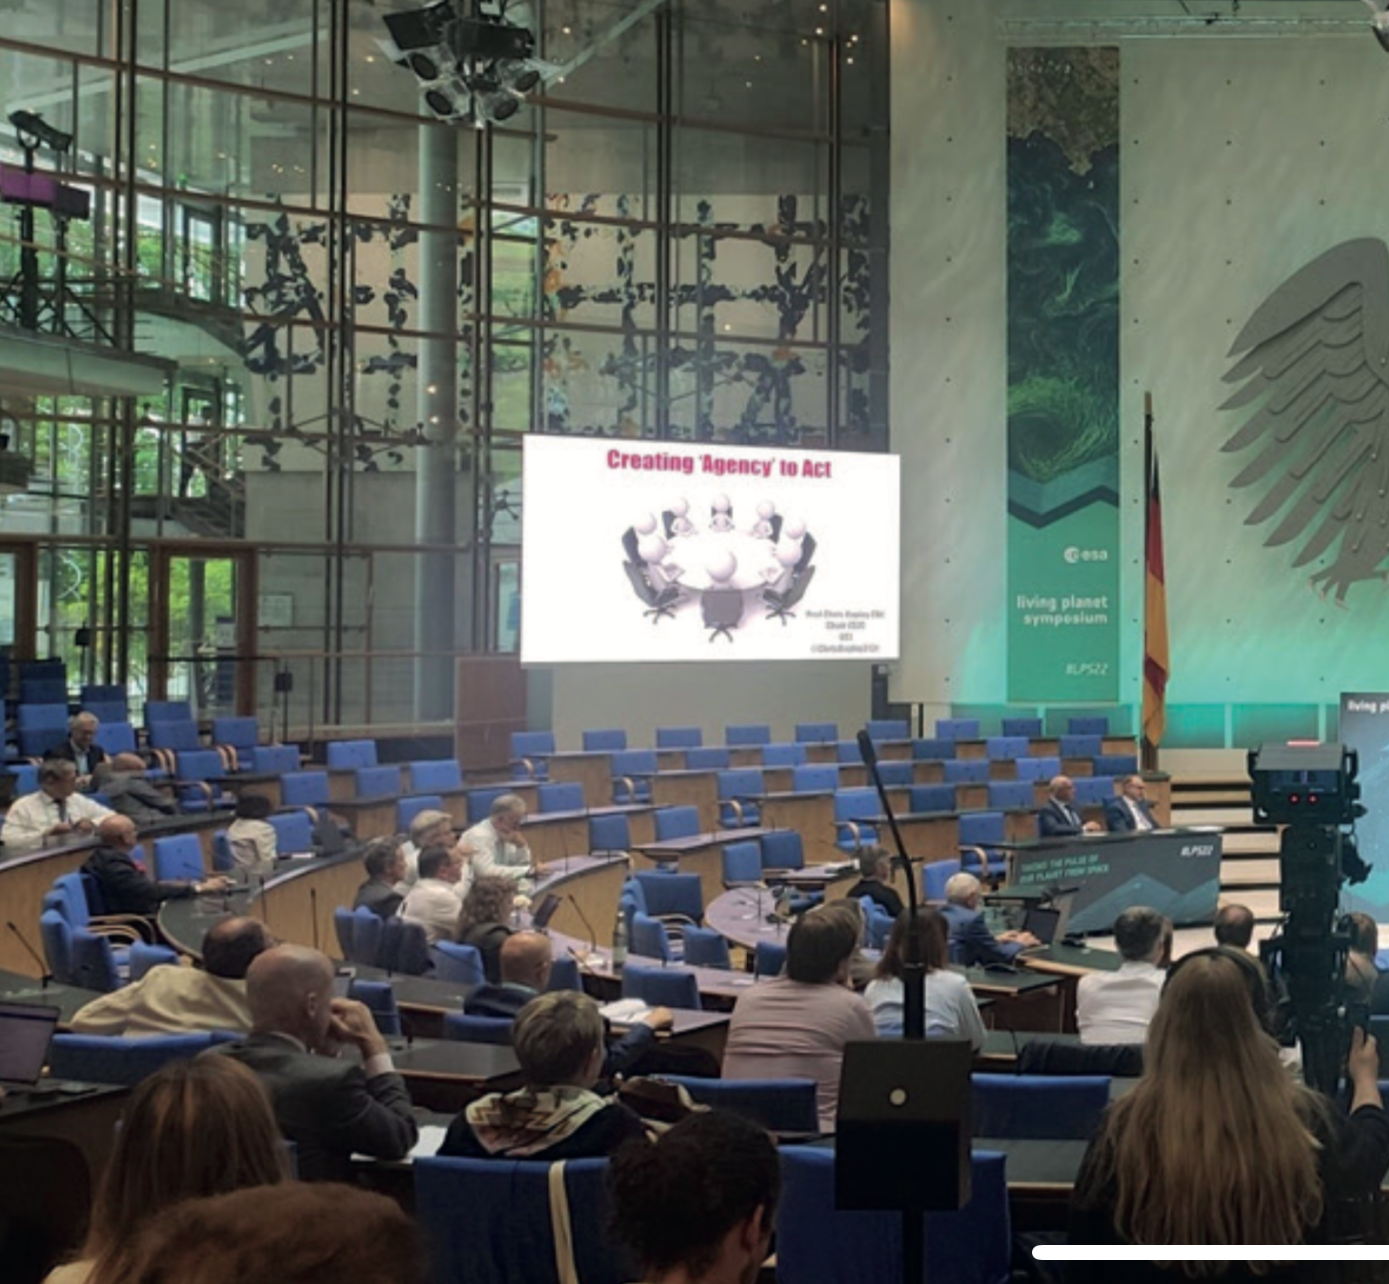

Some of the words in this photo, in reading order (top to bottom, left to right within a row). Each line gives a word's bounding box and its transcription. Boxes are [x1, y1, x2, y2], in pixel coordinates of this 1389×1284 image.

[607, 449, 694, 475] Creating
[779, 459, 798, 477] to
[802, 459, 832, 478] Act
[1016, 595, 1057, 611] living
[1061, 595, 1108, 611] planet
[1023, 611, 1108, 626] symposium
[1347, 700, 1377, 714] living
